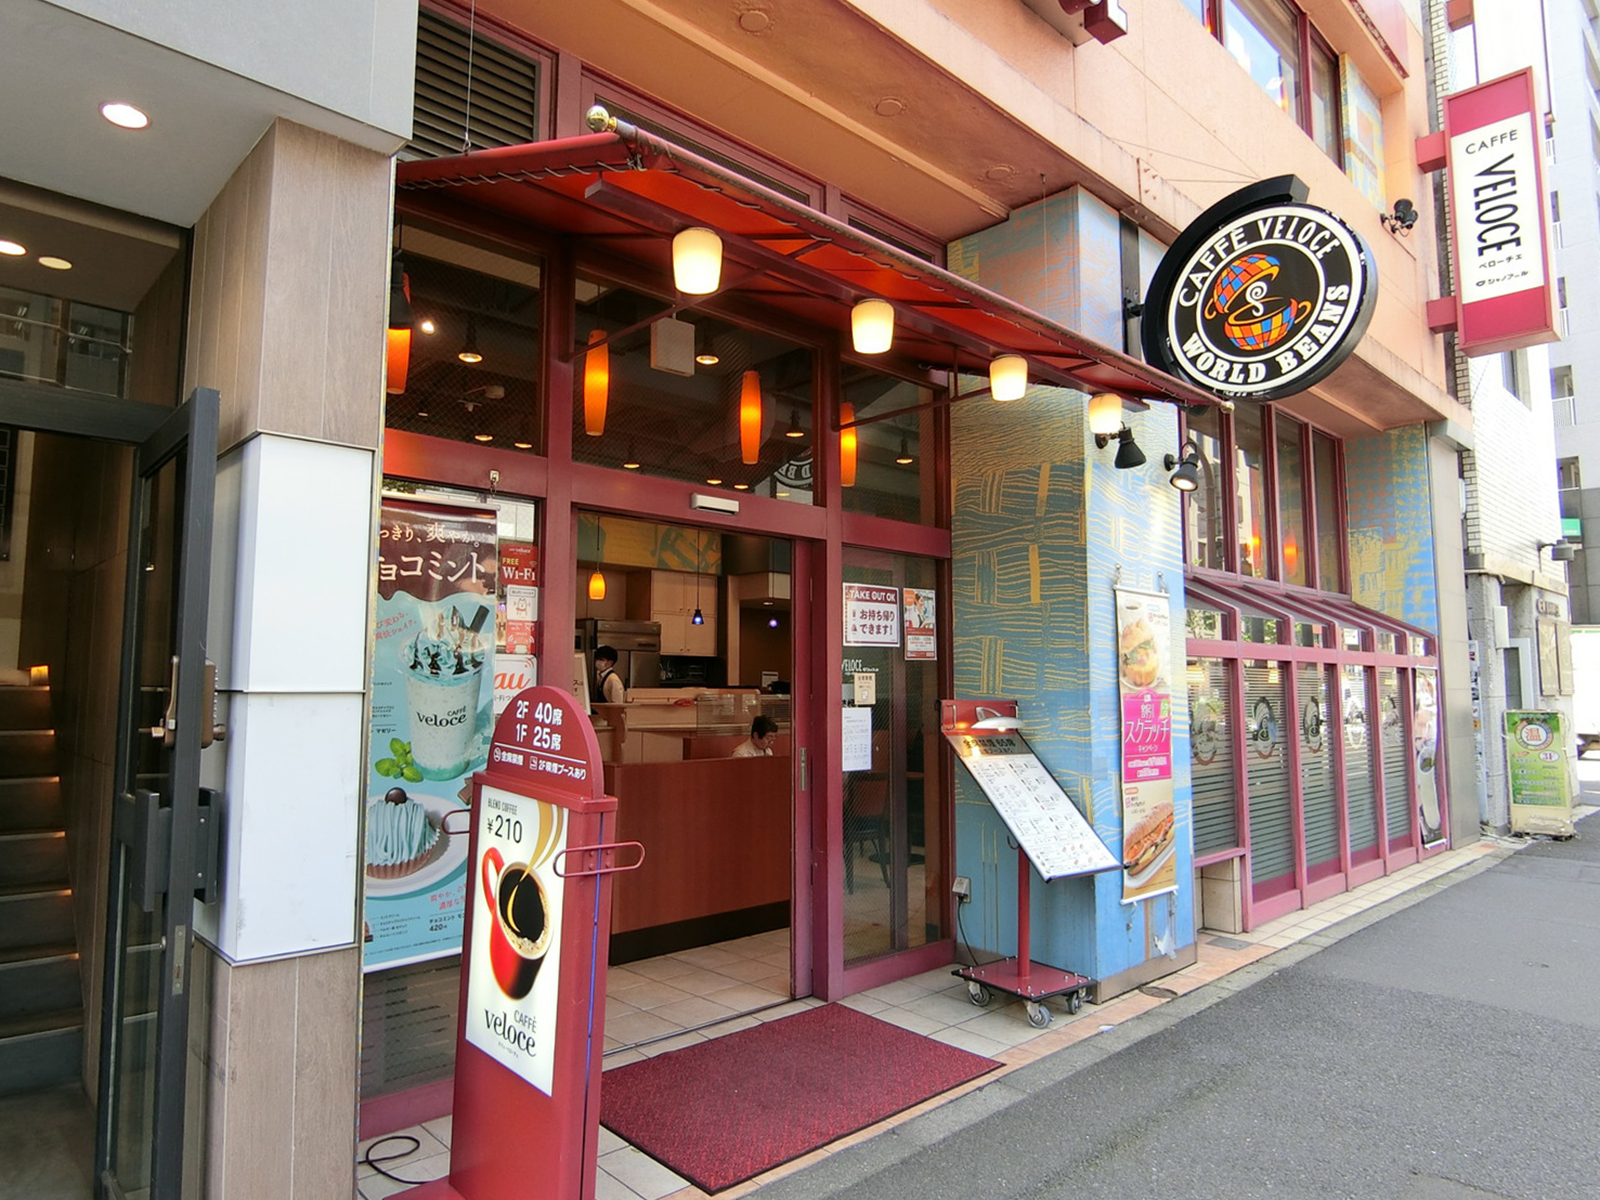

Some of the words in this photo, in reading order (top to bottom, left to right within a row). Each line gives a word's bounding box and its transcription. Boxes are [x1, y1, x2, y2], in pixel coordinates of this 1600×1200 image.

[1473, 153, 1522, 257] VELOCE
[1257, 215, 1341, 260] VELOCE
[1181, 331, 1266, 384] WORLD
[1275, 283, 1350, 375] BEANS
[378, 550, 486, 583] ョコミント
[502, 566, 536, 581] Wi-Fi
[849, 589, 870, 600] TAKE
[871, 591, 885, 601] OUT
[886, 592, 896, 602] OK
[859, 609, 895, 622] お持ち帰り
[494, 672, 531, 690] au
[516, 700, 530, 719] 2F
[534, 702, 563, 726] 40席
[516, 723, 528, 742] 1F
[532, 725, 562, 751] 25席
[1124, 718, 1170, 744] スクラッチ
[487, 797, 501, 810] BLEND
[501, 801, 518, 816] COFFEE
